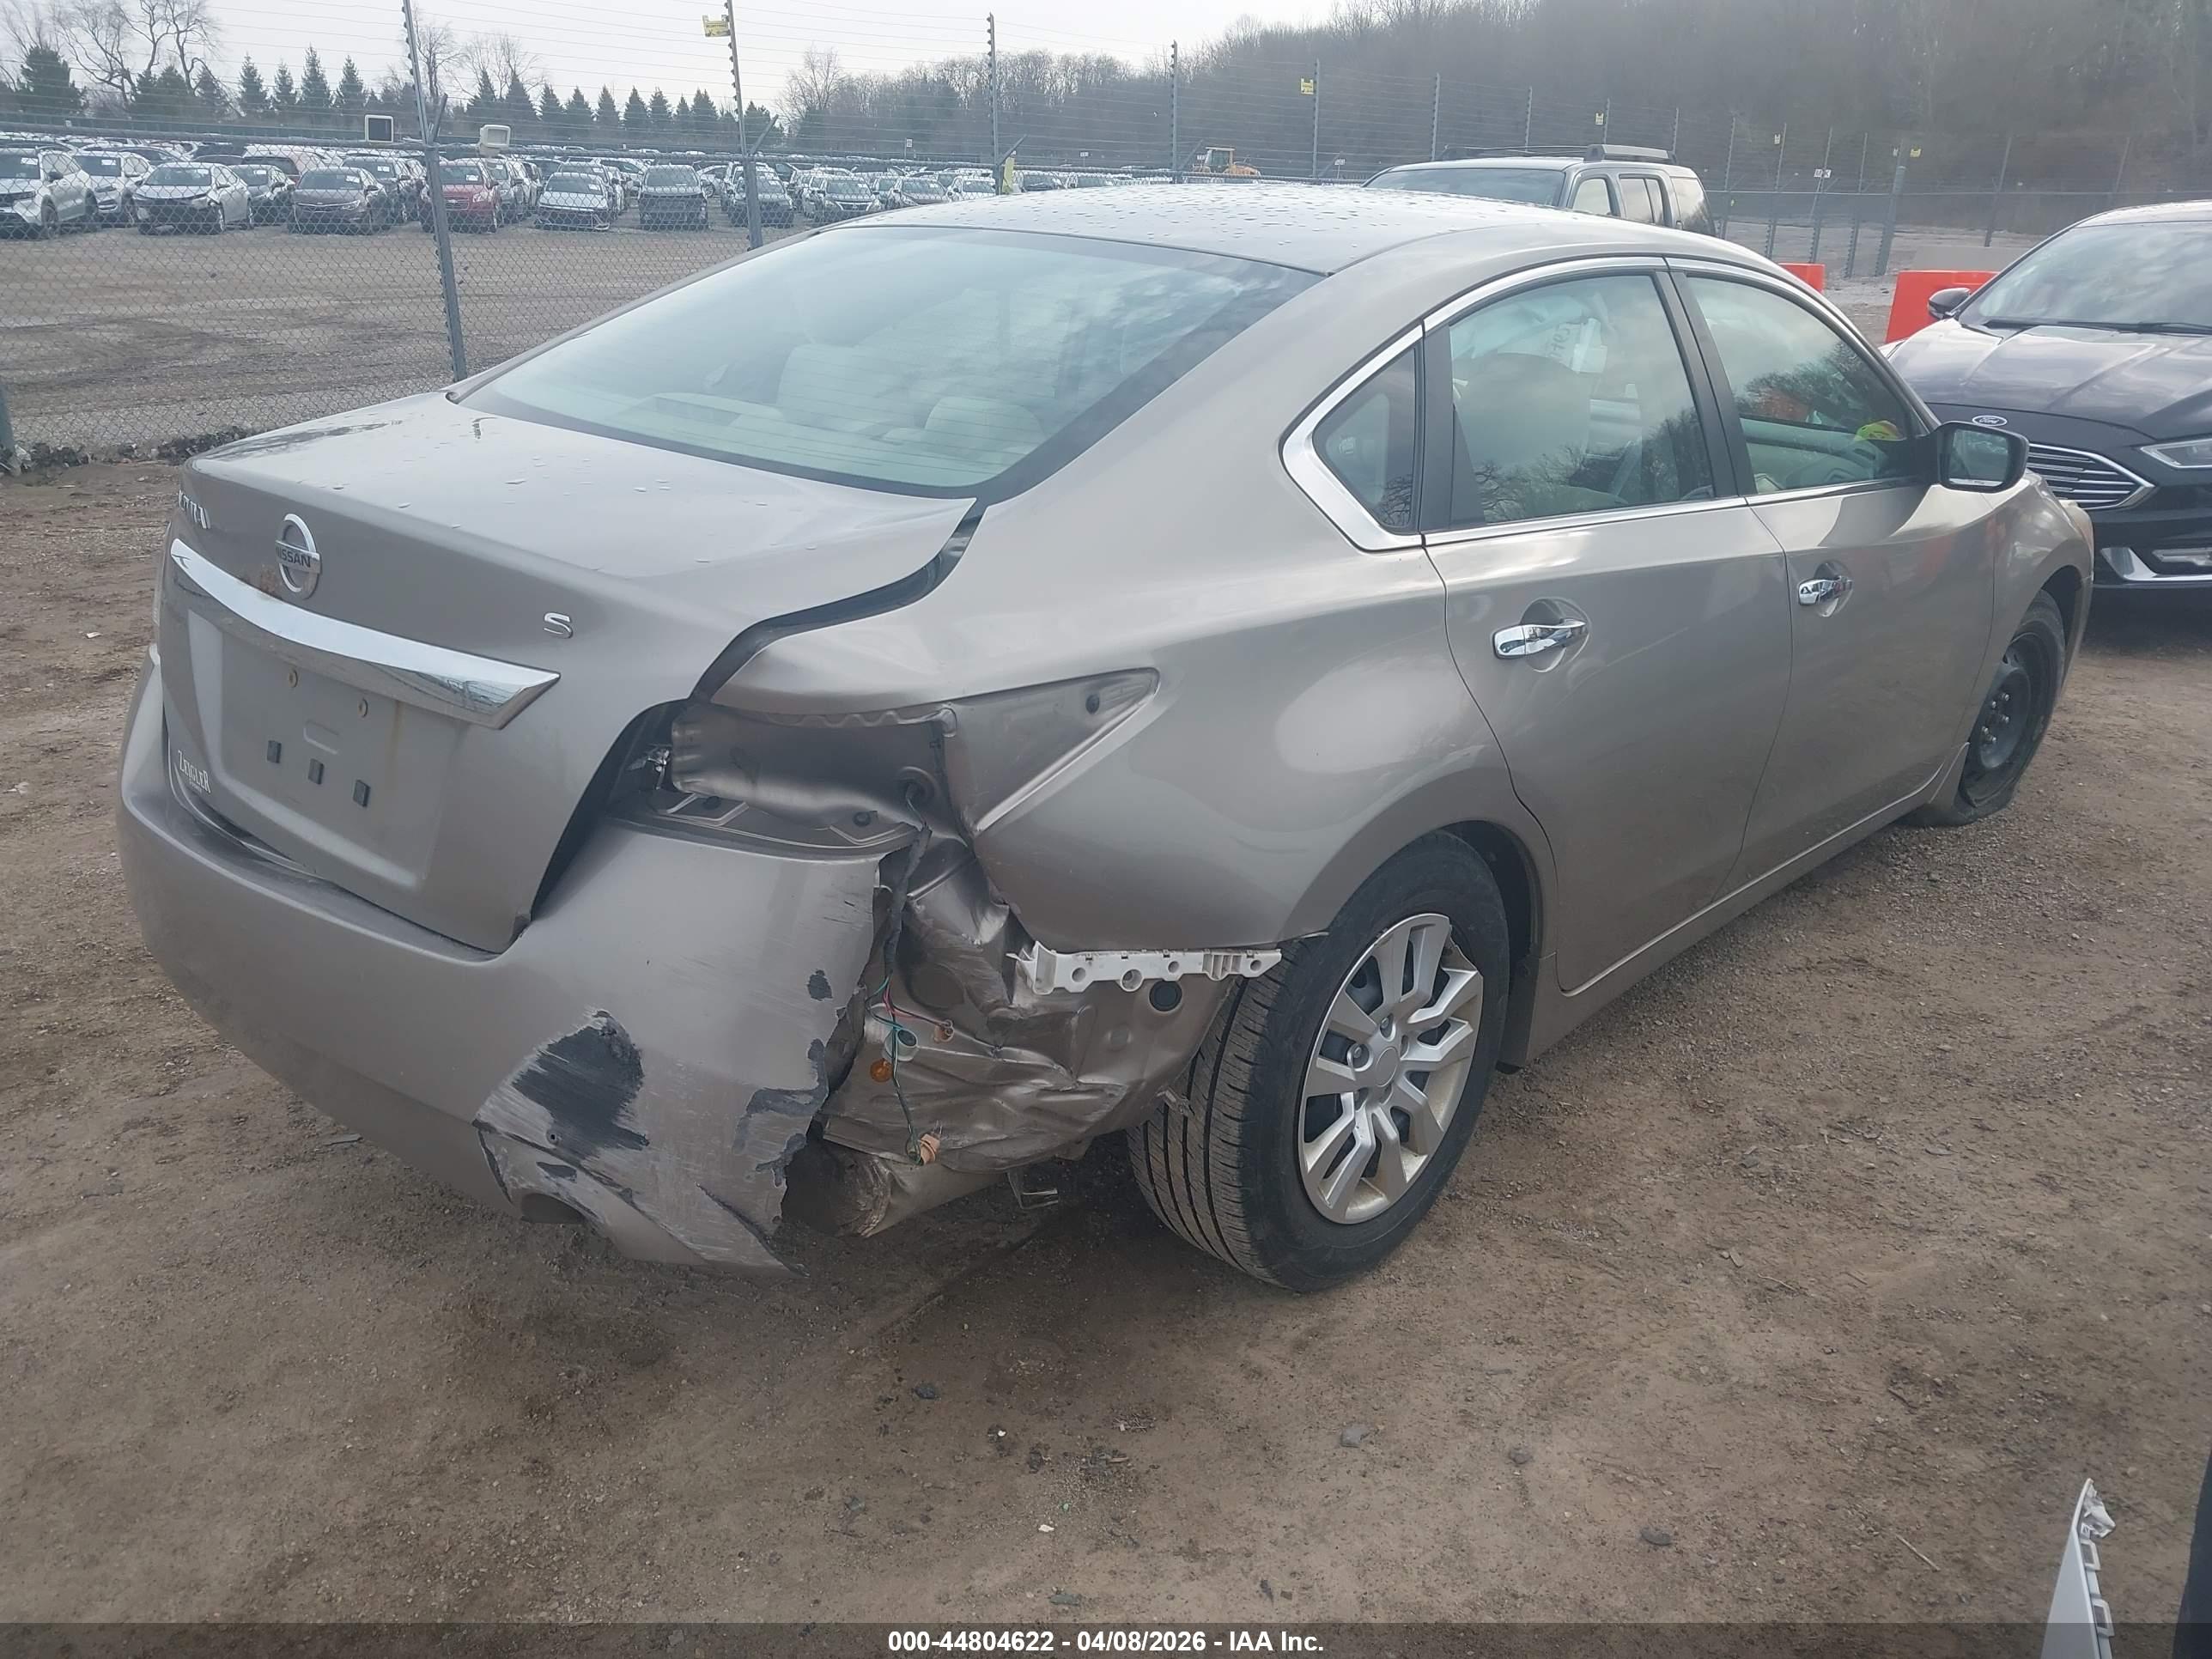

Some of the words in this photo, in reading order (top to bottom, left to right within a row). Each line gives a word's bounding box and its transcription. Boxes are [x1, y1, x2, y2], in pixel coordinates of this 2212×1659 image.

[276, 545, 311, 568] NISSAN
[544, 612, 573, 639] S
[178, 750, 211, 793] ZEIGLER
